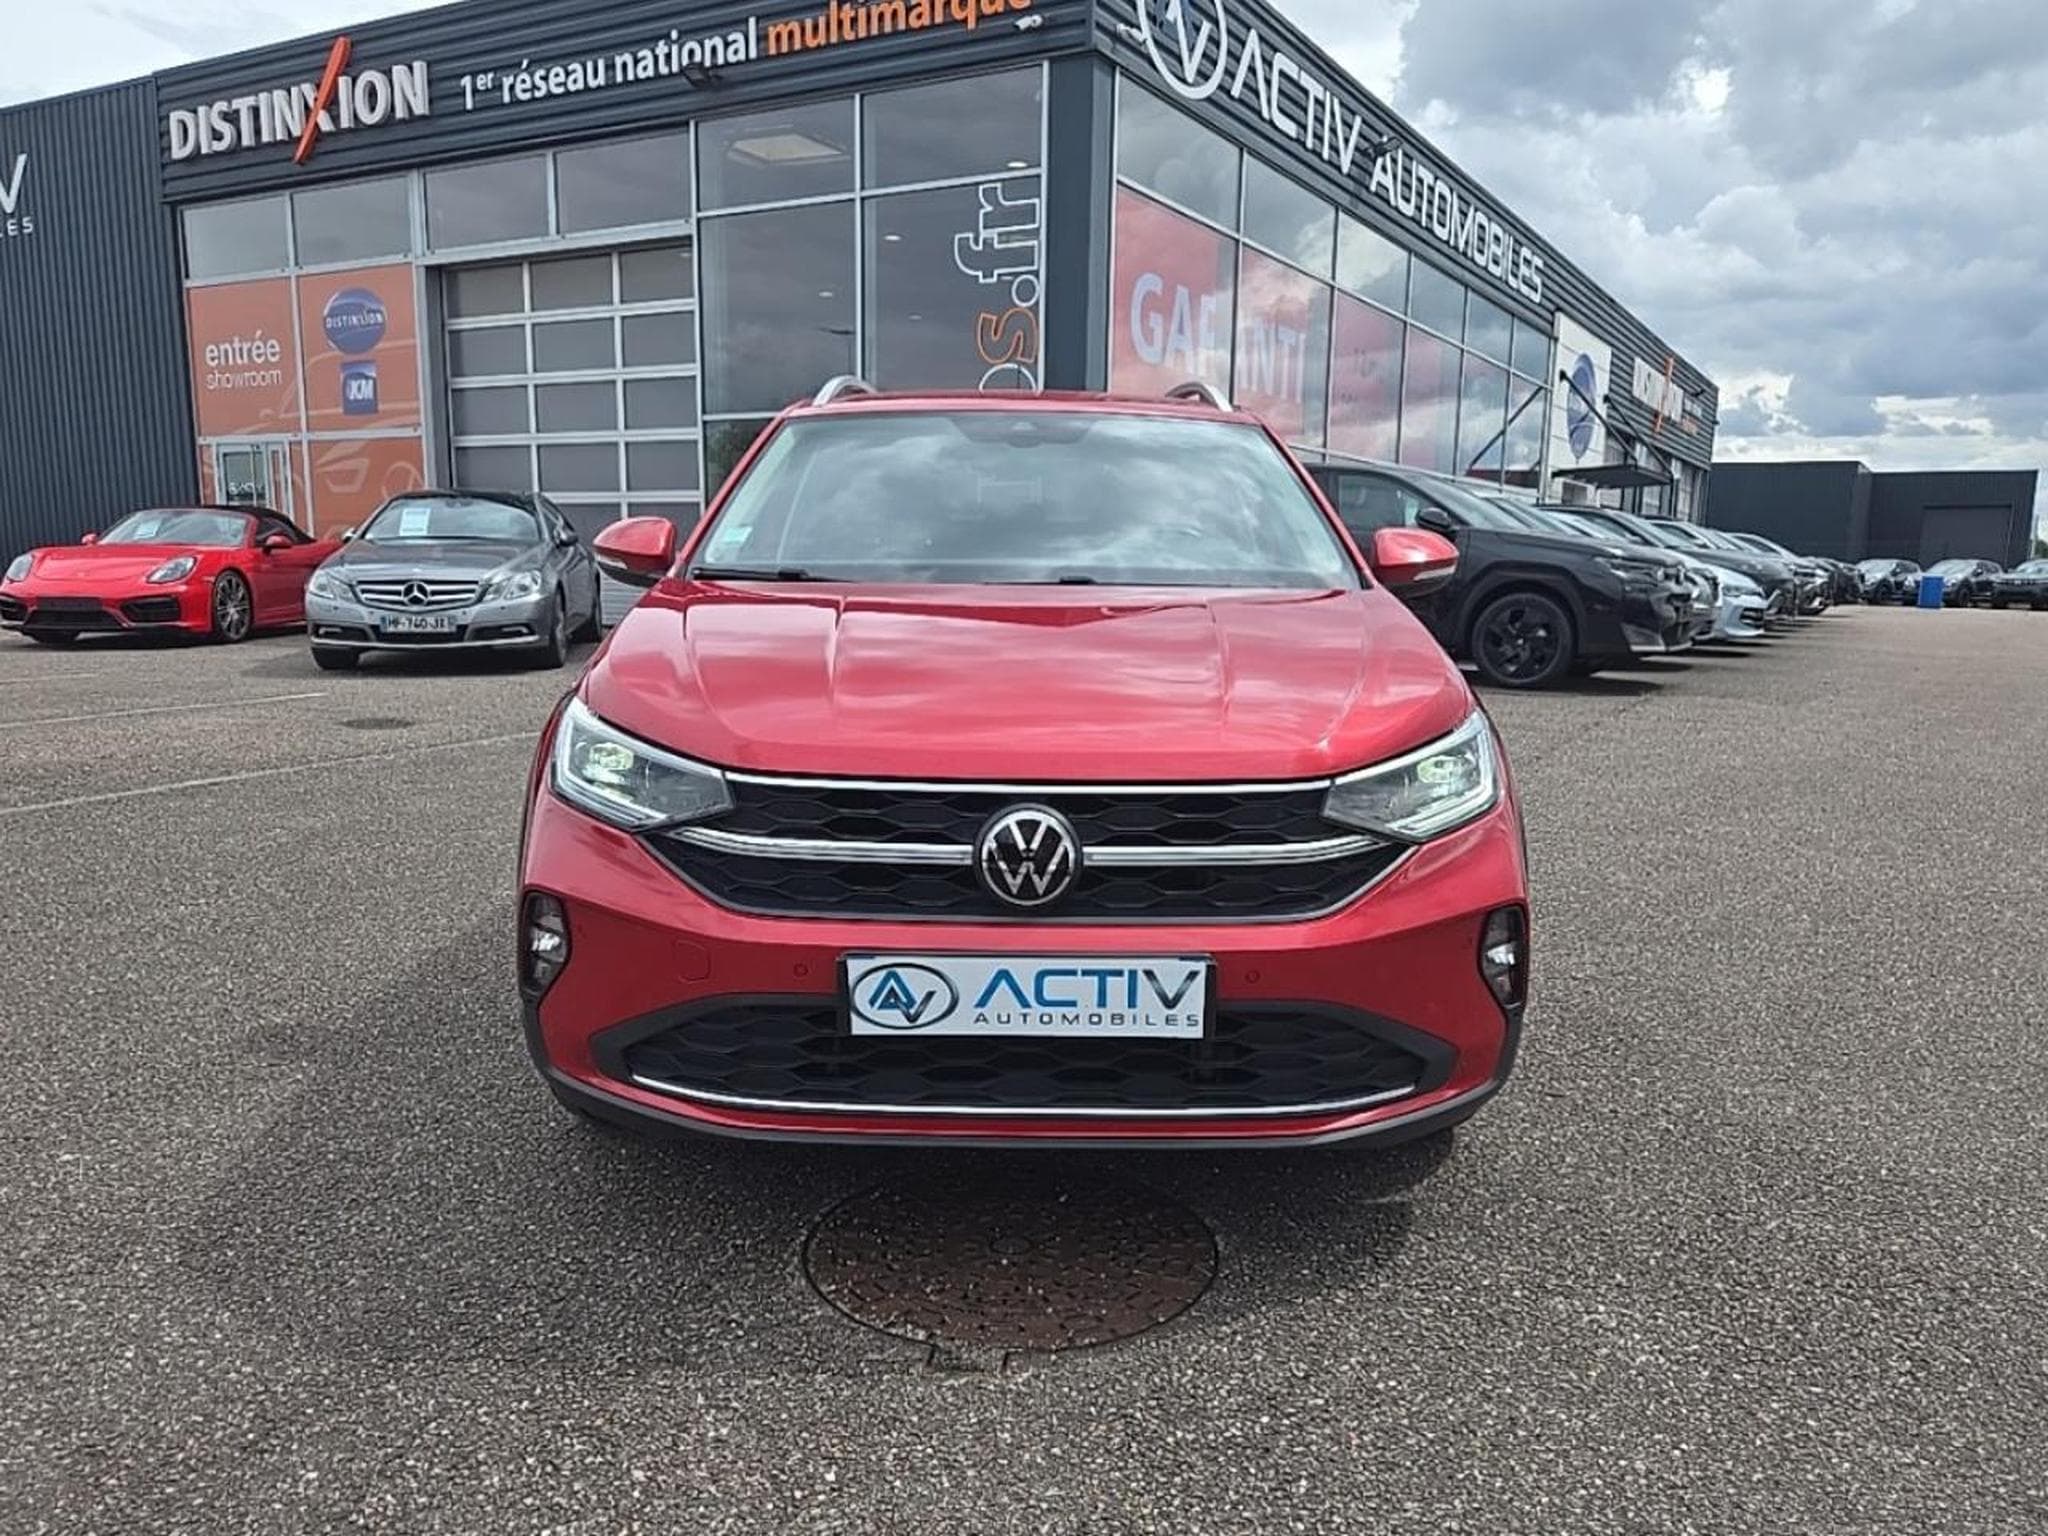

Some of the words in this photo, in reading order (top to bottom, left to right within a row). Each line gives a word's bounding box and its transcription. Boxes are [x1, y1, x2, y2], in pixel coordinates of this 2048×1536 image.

[502, 58, 606, 104] réseau
[615, 16, 758, 83] national
[169, 36, 431, 164] DISTINXION
[1230, 28, 1362, 175] ACTIV
[1370, 148, 1543, 304] AUTOMOBILES
[0, 216, 34, 237] ES
[205, 329, 281, 366] entrée
[206, 368, 282, 389] showroom
[974, 968, 1201, 1011] ACTIV
[973, 1012, 1200, 1027] AUTOMOBILES
